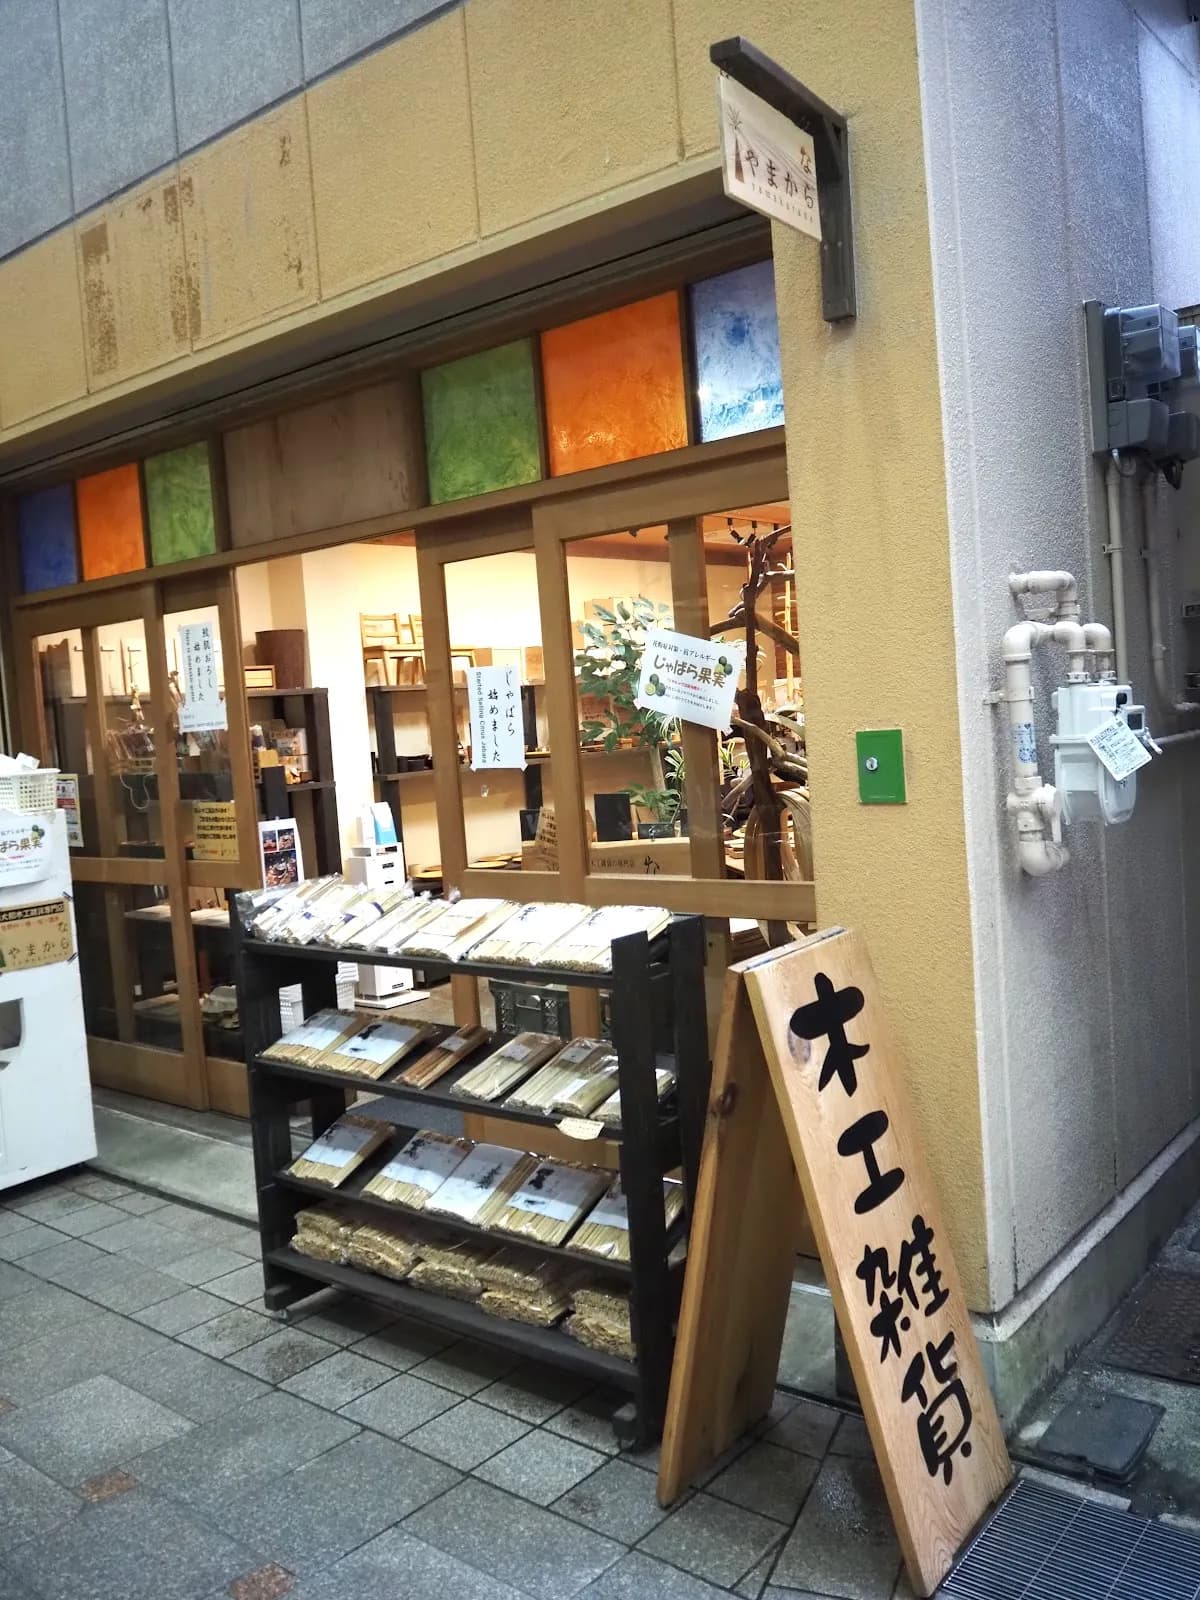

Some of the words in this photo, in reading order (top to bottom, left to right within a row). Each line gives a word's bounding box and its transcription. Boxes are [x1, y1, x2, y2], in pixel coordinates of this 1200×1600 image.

[745, 149, 814, 209] やまから
[505, 668, 516, 737] じゃばら
[654, 653, 727, 689] じゃばら果実
[487, 688, 503, 763] 始めました
[8, 937, 70, 960] やまから
[788, 971, 973, 1487] 木工雑貨
